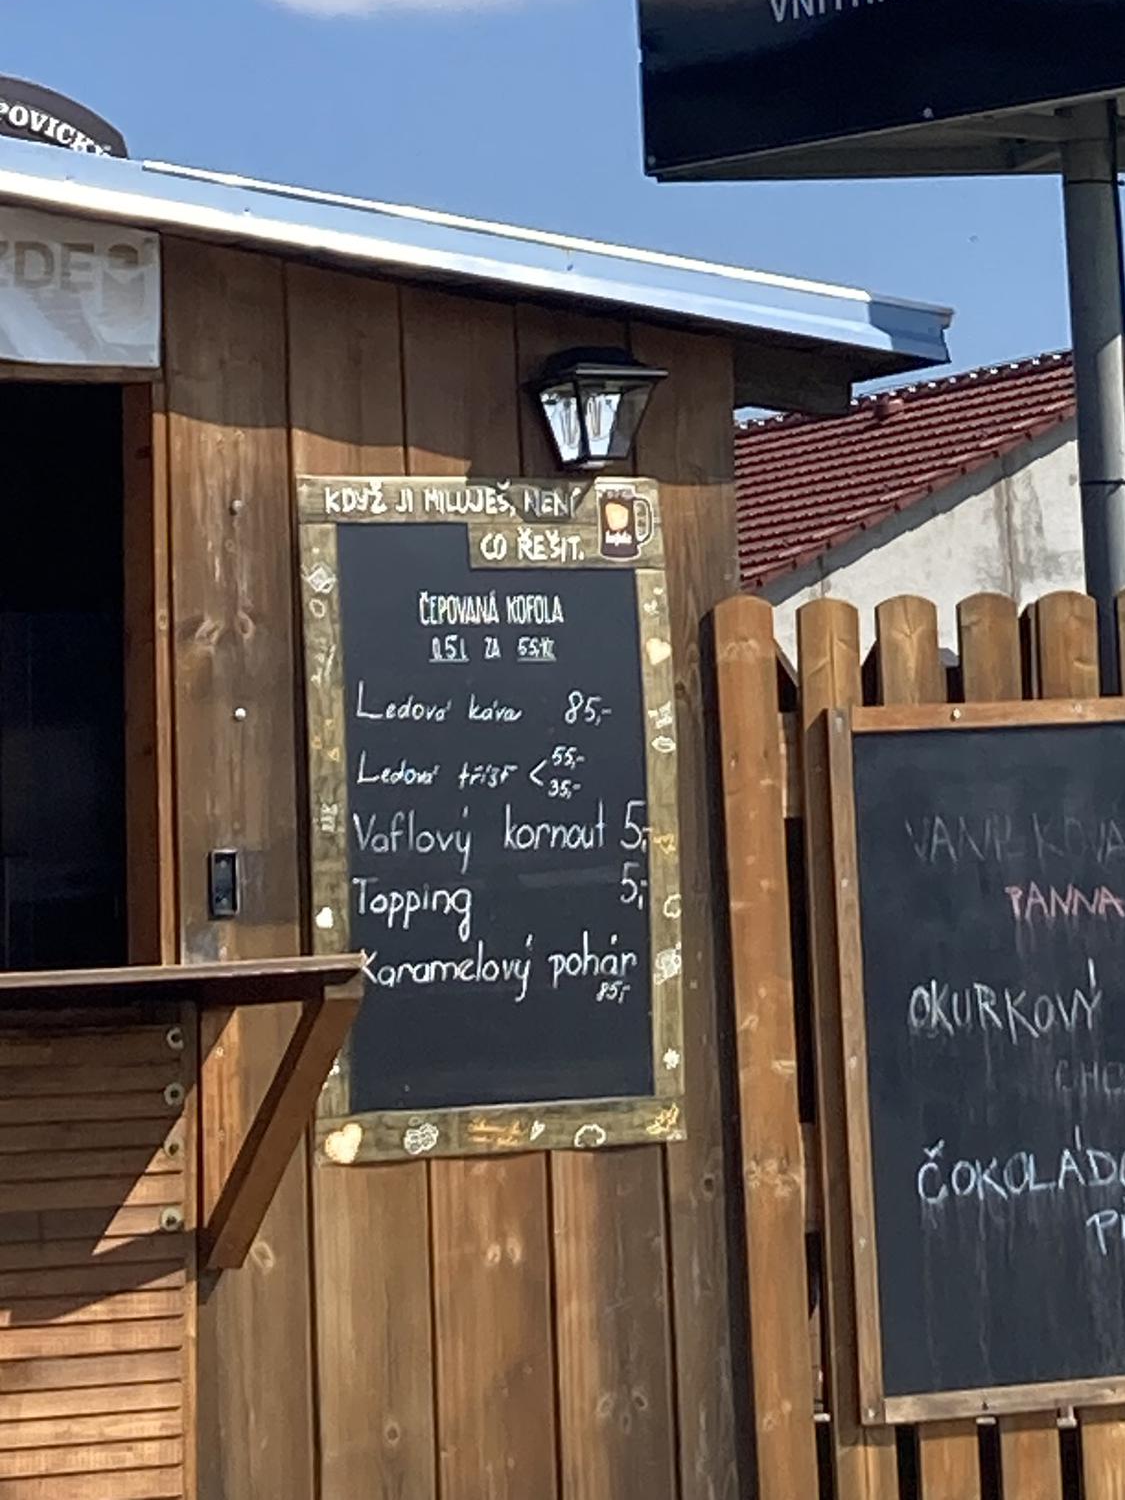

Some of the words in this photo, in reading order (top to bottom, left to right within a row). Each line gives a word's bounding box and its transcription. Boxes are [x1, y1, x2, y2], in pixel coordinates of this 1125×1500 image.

[324, 479, 388, 514] KDYŽ
[395, 487, 414, 513] JI
[480, 532, 507, 561] CO
[419, 588, 500, 626] ČEPOVANÁ
[506, 594, 564, 624] KOFOLA
[484, 636, 501, 659] ZA
[356, 681, 451, 722] Ledová
[468, 694, 522, 721] káva
[564, 691, 612, 726] 85,-
[353, 805, 472, 875] Vaflový
[503, 799, 606, 849] kornout
[352, 877, 472, 942] Topping
[1004, 880, 1125, 920] PANNA
[360, 933, 534, 1002] Karamelový
[549, 930, 638, 988] pohár
[908, 957, 1102, 1045] OKURKOVÝ
